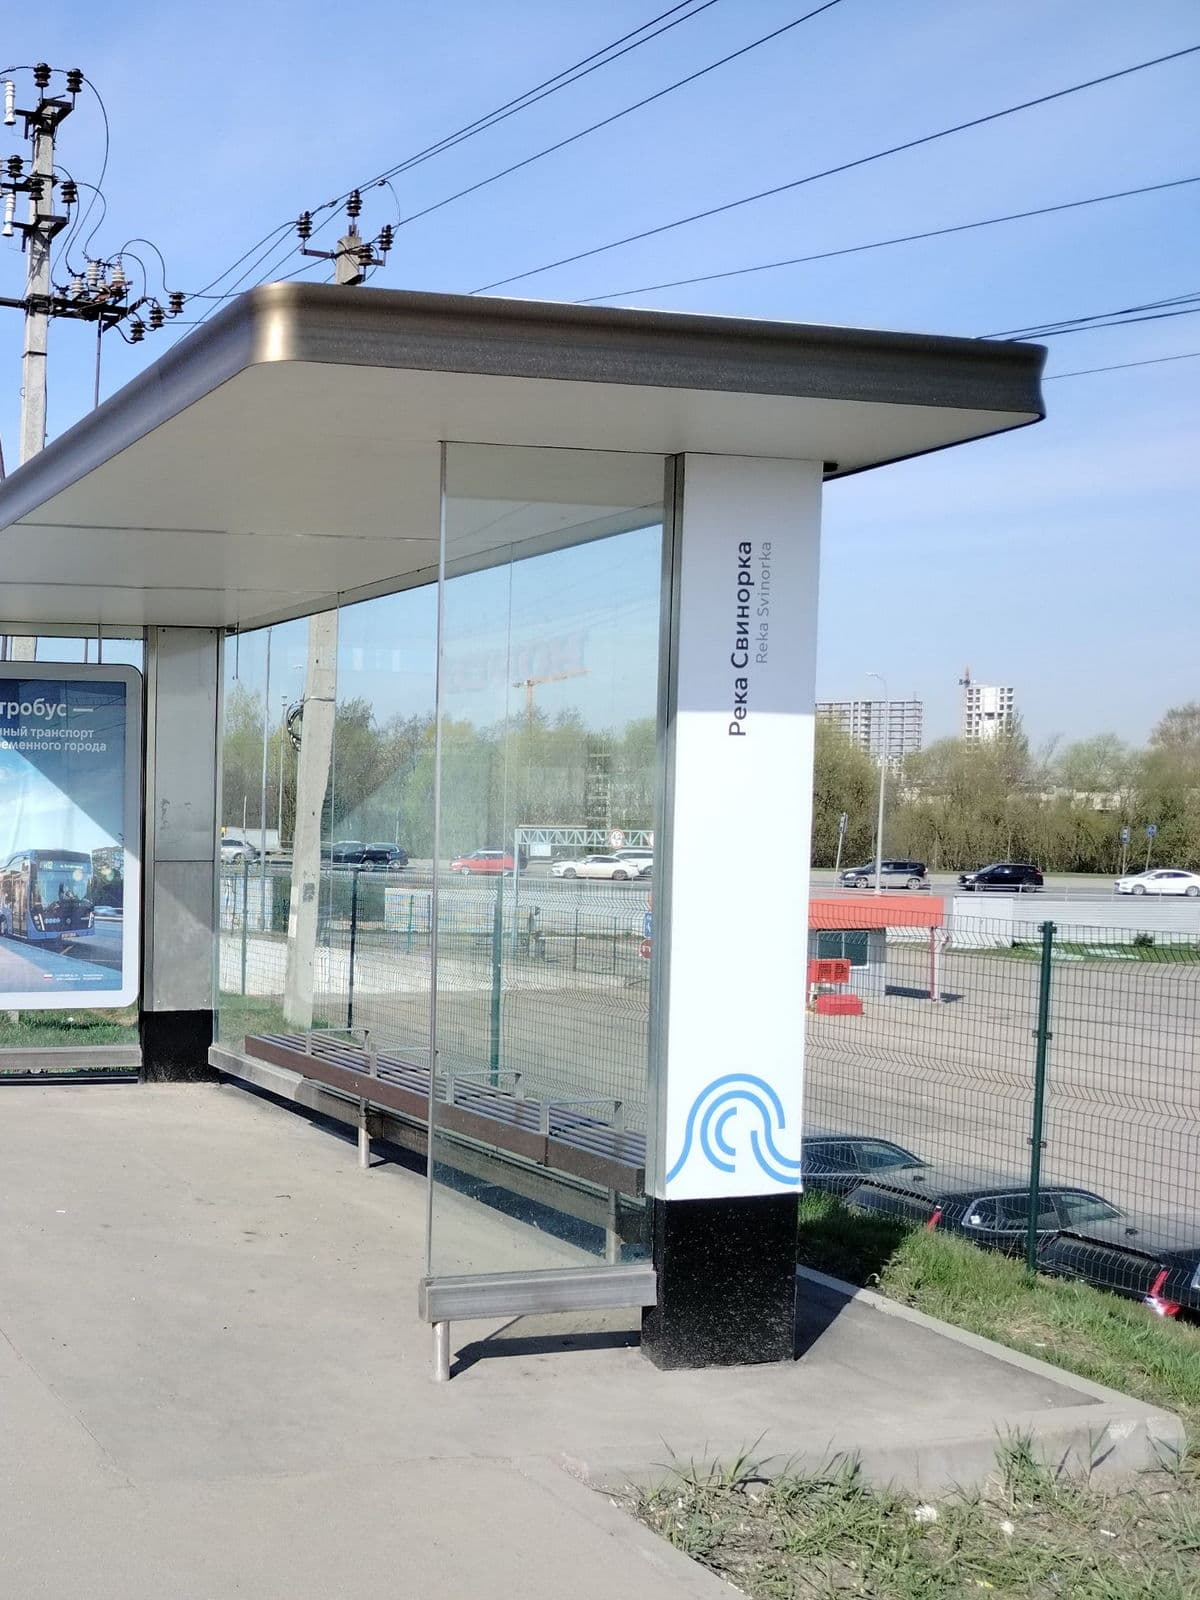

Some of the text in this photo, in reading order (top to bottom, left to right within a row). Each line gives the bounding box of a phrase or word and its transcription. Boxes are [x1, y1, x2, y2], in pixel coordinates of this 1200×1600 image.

[756, 542, 772, 664] Reka Svinorka
[728, 541, 755, 736] Река Свинорка
[30, 728, 95, 740] транспорт
[64, 742, 107, 752] города
